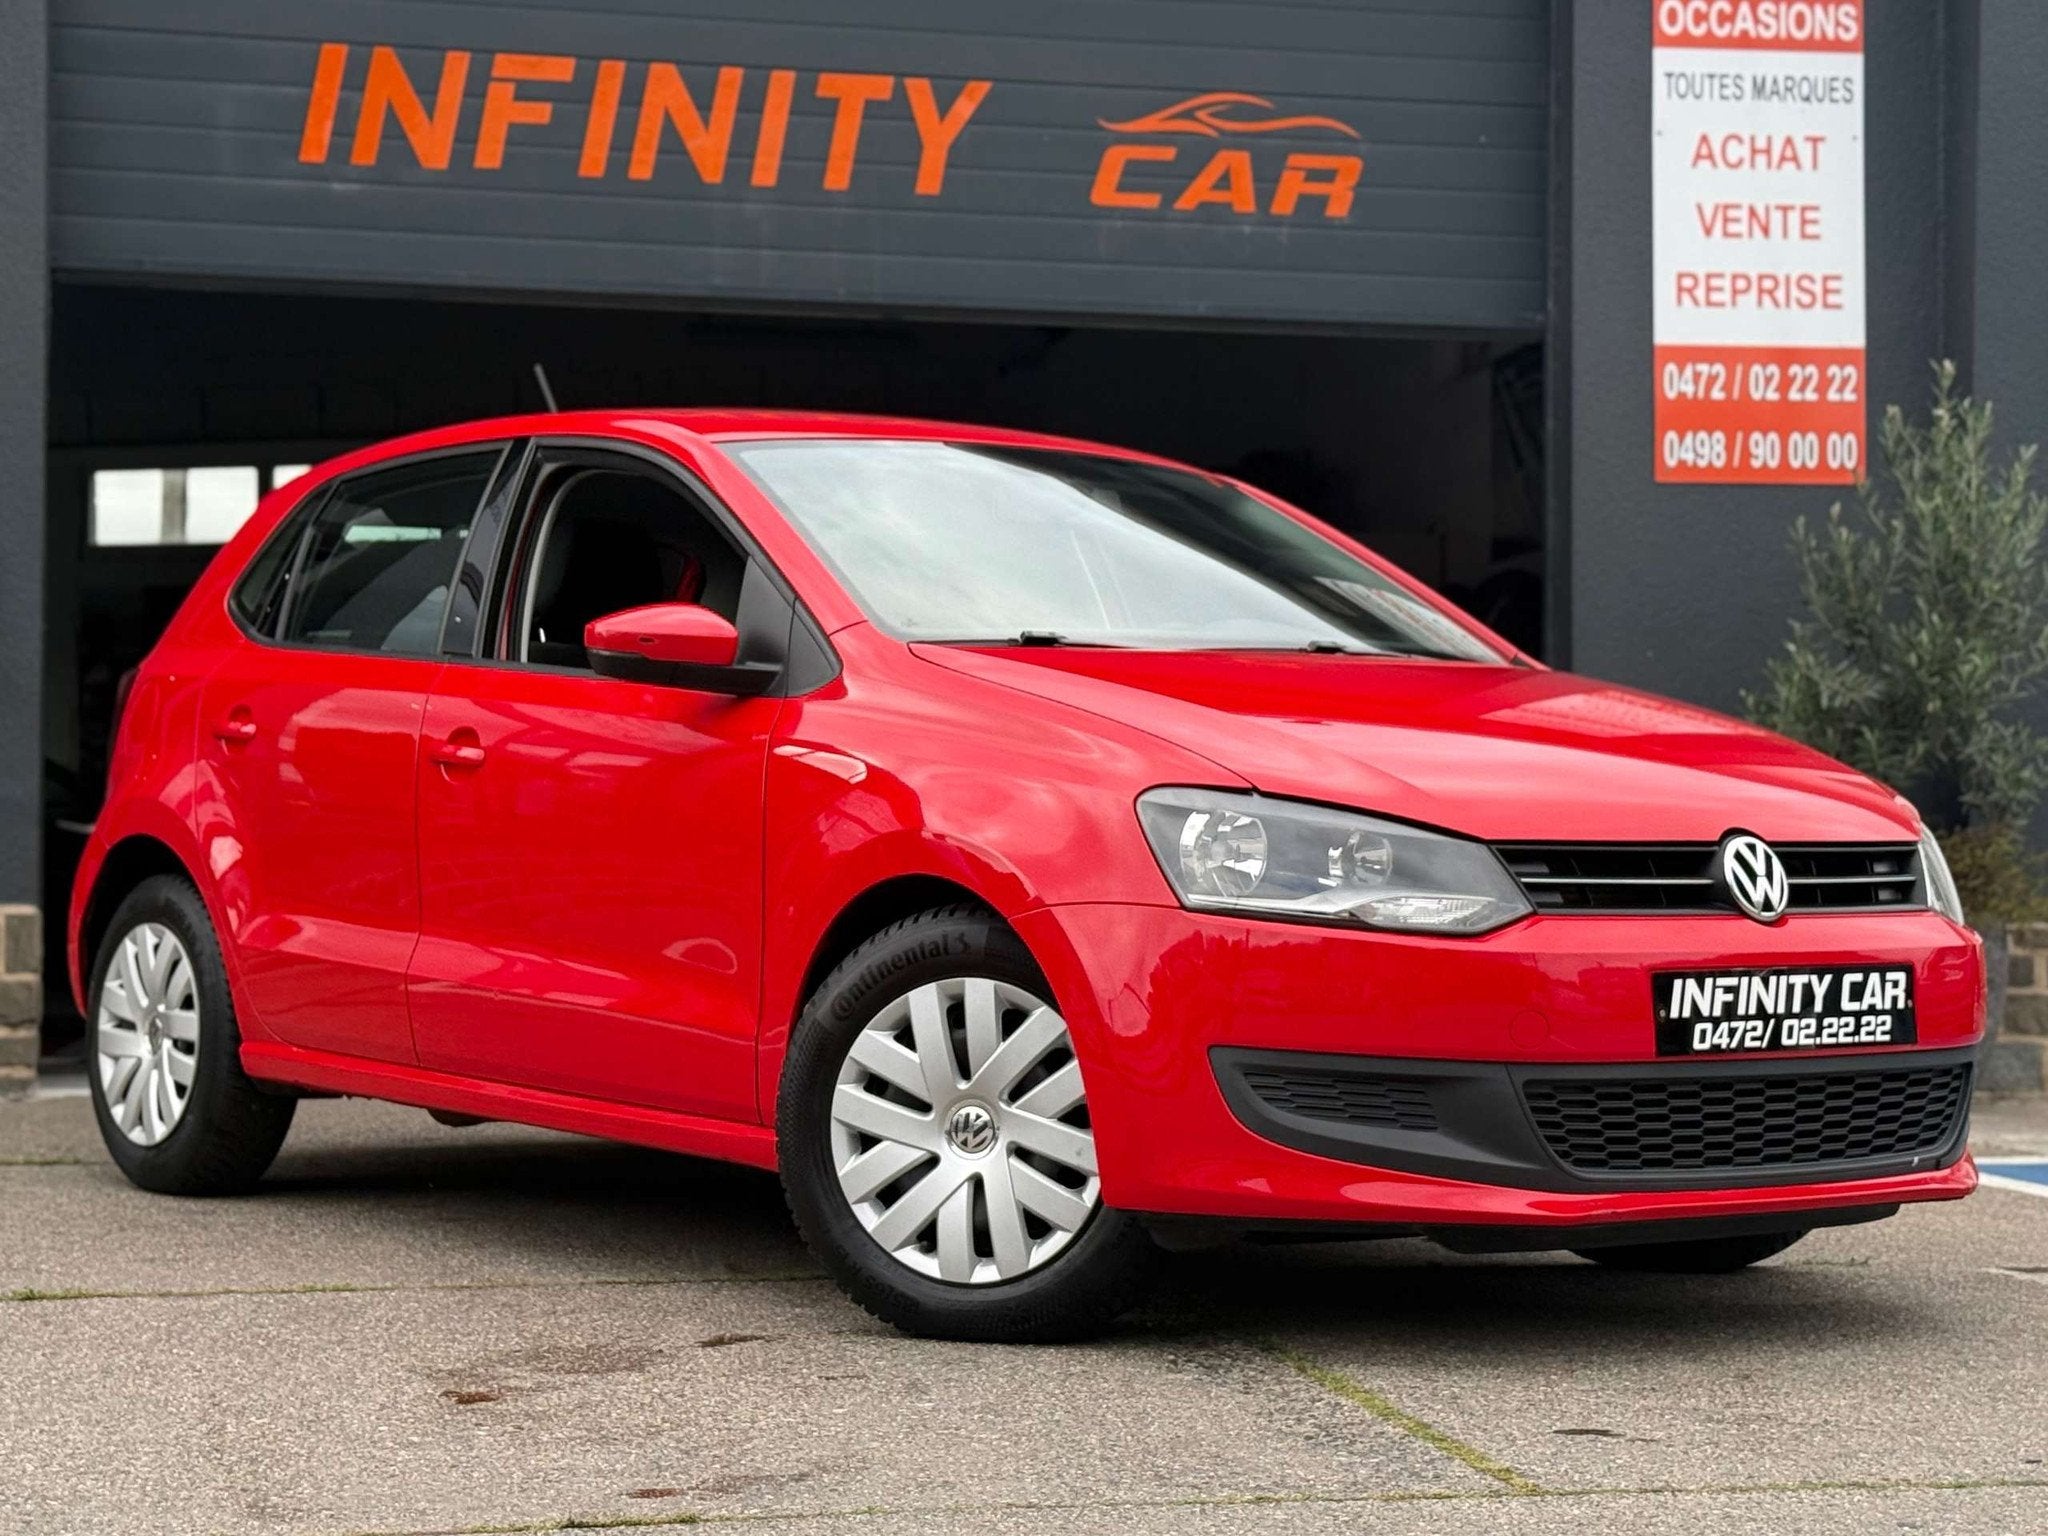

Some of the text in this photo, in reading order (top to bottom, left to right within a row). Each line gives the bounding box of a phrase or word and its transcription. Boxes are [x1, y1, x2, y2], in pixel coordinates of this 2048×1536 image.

[1659, 0, 1858, 40] OCCASIONS
[1665, 72, 1854, 103] TOUTES MARQUES
[299, 43, 1363, 217] INFINITY CAR
[1692, 134, 1826, 170] ACHAT
[1697, 203, 1821, 240] VENTE
[1675, 272, 1843, 309] REPRISE
[1663, 363, 1726, 400] 0472
[1749, 364, 1781, 401] 02
[1787, 365, 1819, 401] 22
[1826, 365, 1858, 402] 22
[1663, 431, 1727, 468] 0498
[1749, 432, 1781, 468] 90
[1788, 432, 1819, 468] 00
[1826, 433, 1858, 470] 00
[832, 932, 950, 1019] Continental
[1669, 971, 1907, 1018] INFINITY CAR
[1693, 1015, 1892, 1050] 0472/ 02.22.22
